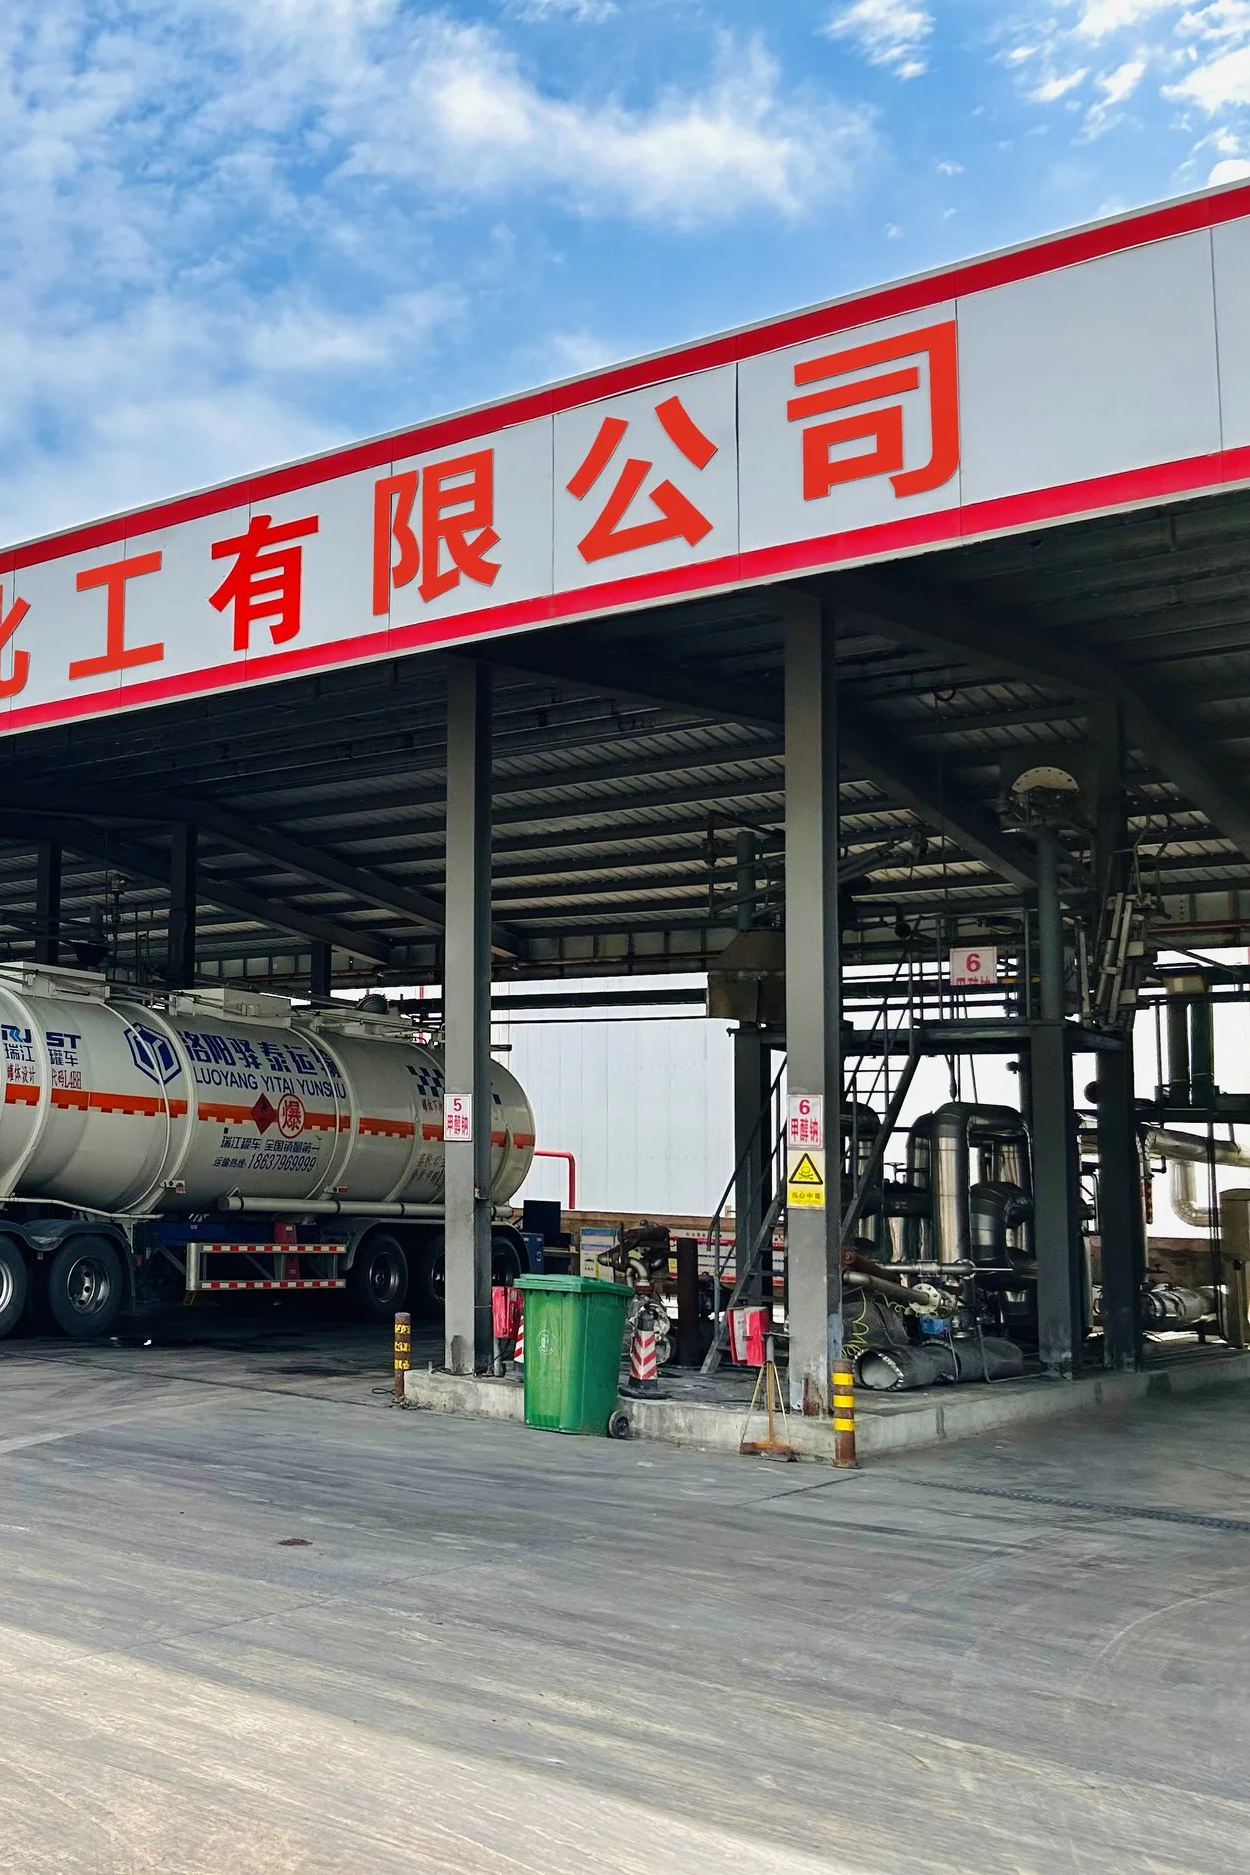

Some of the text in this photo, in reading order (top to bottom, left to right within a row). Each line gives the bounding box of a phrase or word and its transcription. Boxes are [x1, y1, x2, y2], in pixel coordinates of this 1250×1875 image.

[965, 953, 981, 973] 6
[176, 1028, 343, 1079] 洛阳驿泰运输
[192, 1066, 259, 1091] LUOYANG
[260, 1074, 295, 1095] YITAI
[282, 1099, 302, 1131] 爆
[453, 1098, 462, 1112] 5
[799, 1099, 811, 1115] 6
[447, 1113, 469, 1136] 甲醇钠
[791, 1117, 819, 1143] 甲醇钠
[248, 1152, 317, 1173] 18637969999
[792, 1191, 821, 1200] 当心中毒
